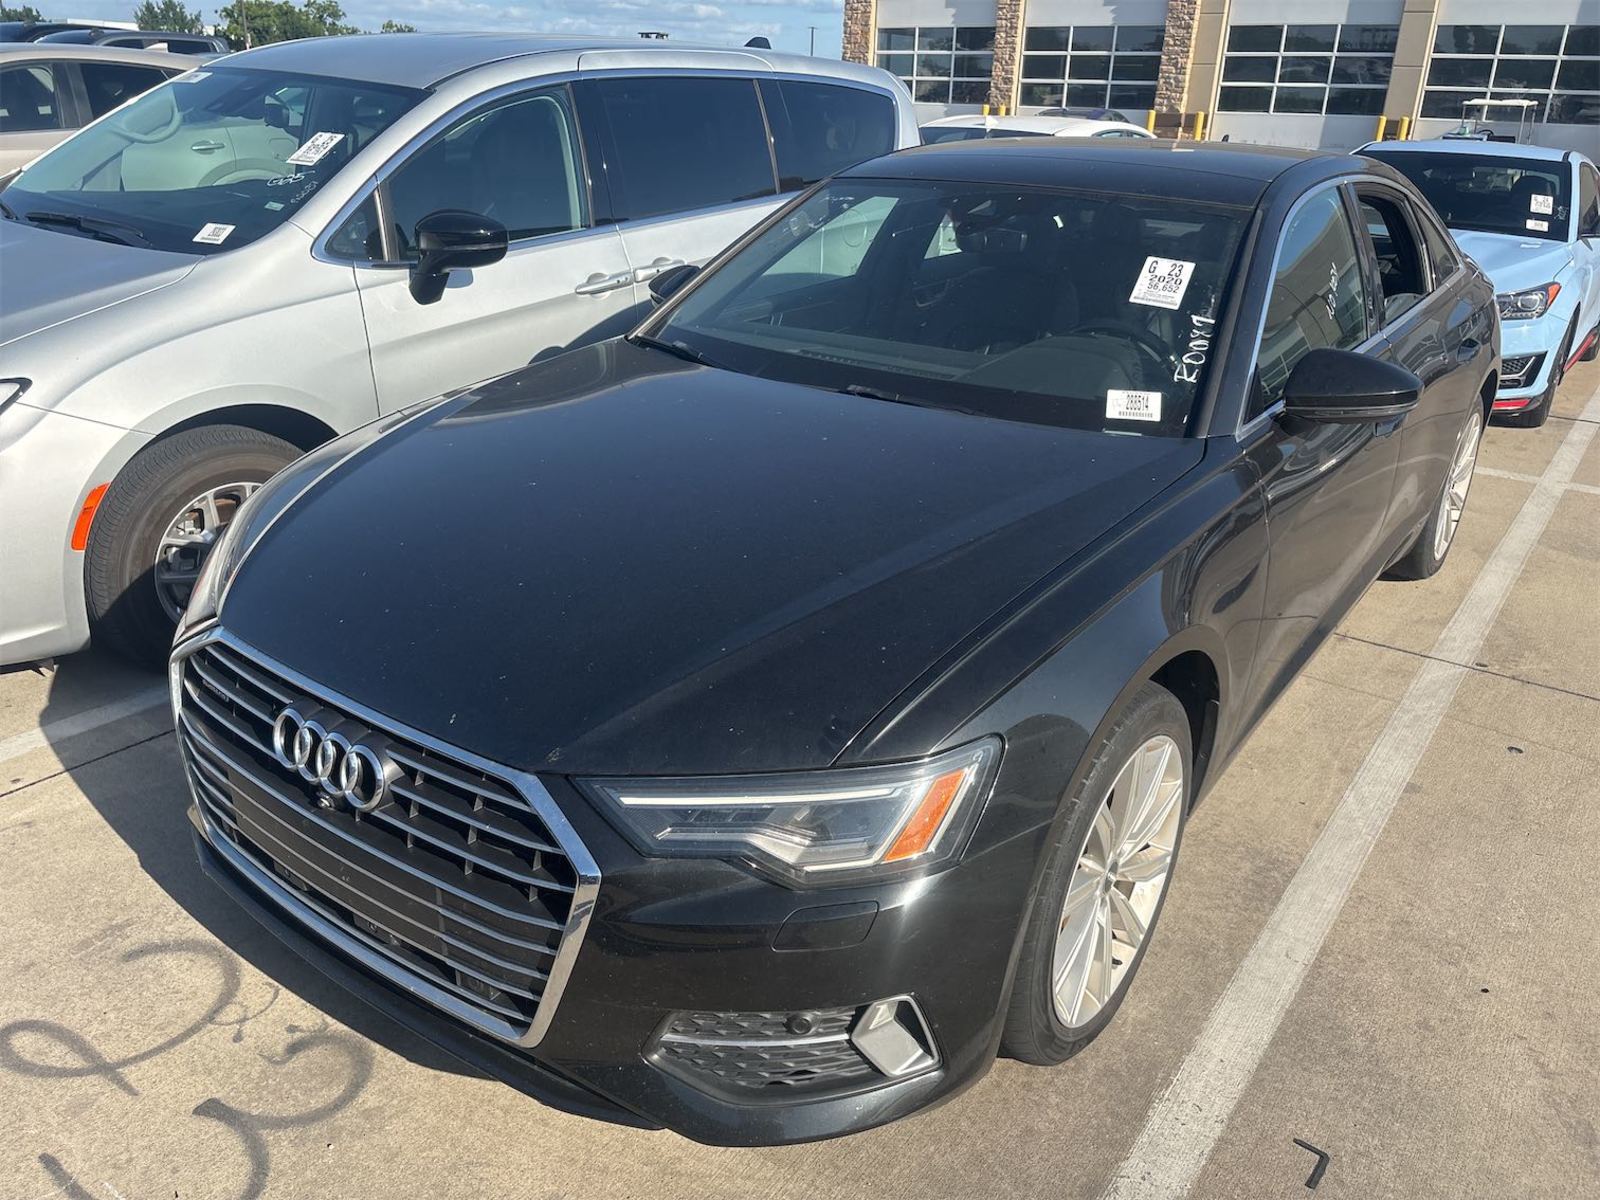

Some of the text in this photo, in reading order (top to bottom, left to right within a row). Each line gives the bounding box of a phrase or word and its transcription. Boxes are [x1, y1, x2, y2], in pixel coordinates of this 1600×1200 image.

[1148, 260, 1184, 278] G 23
[1148, 274, 1183, 286] 2020
[1147, 281, 1180, 294] 56,652
